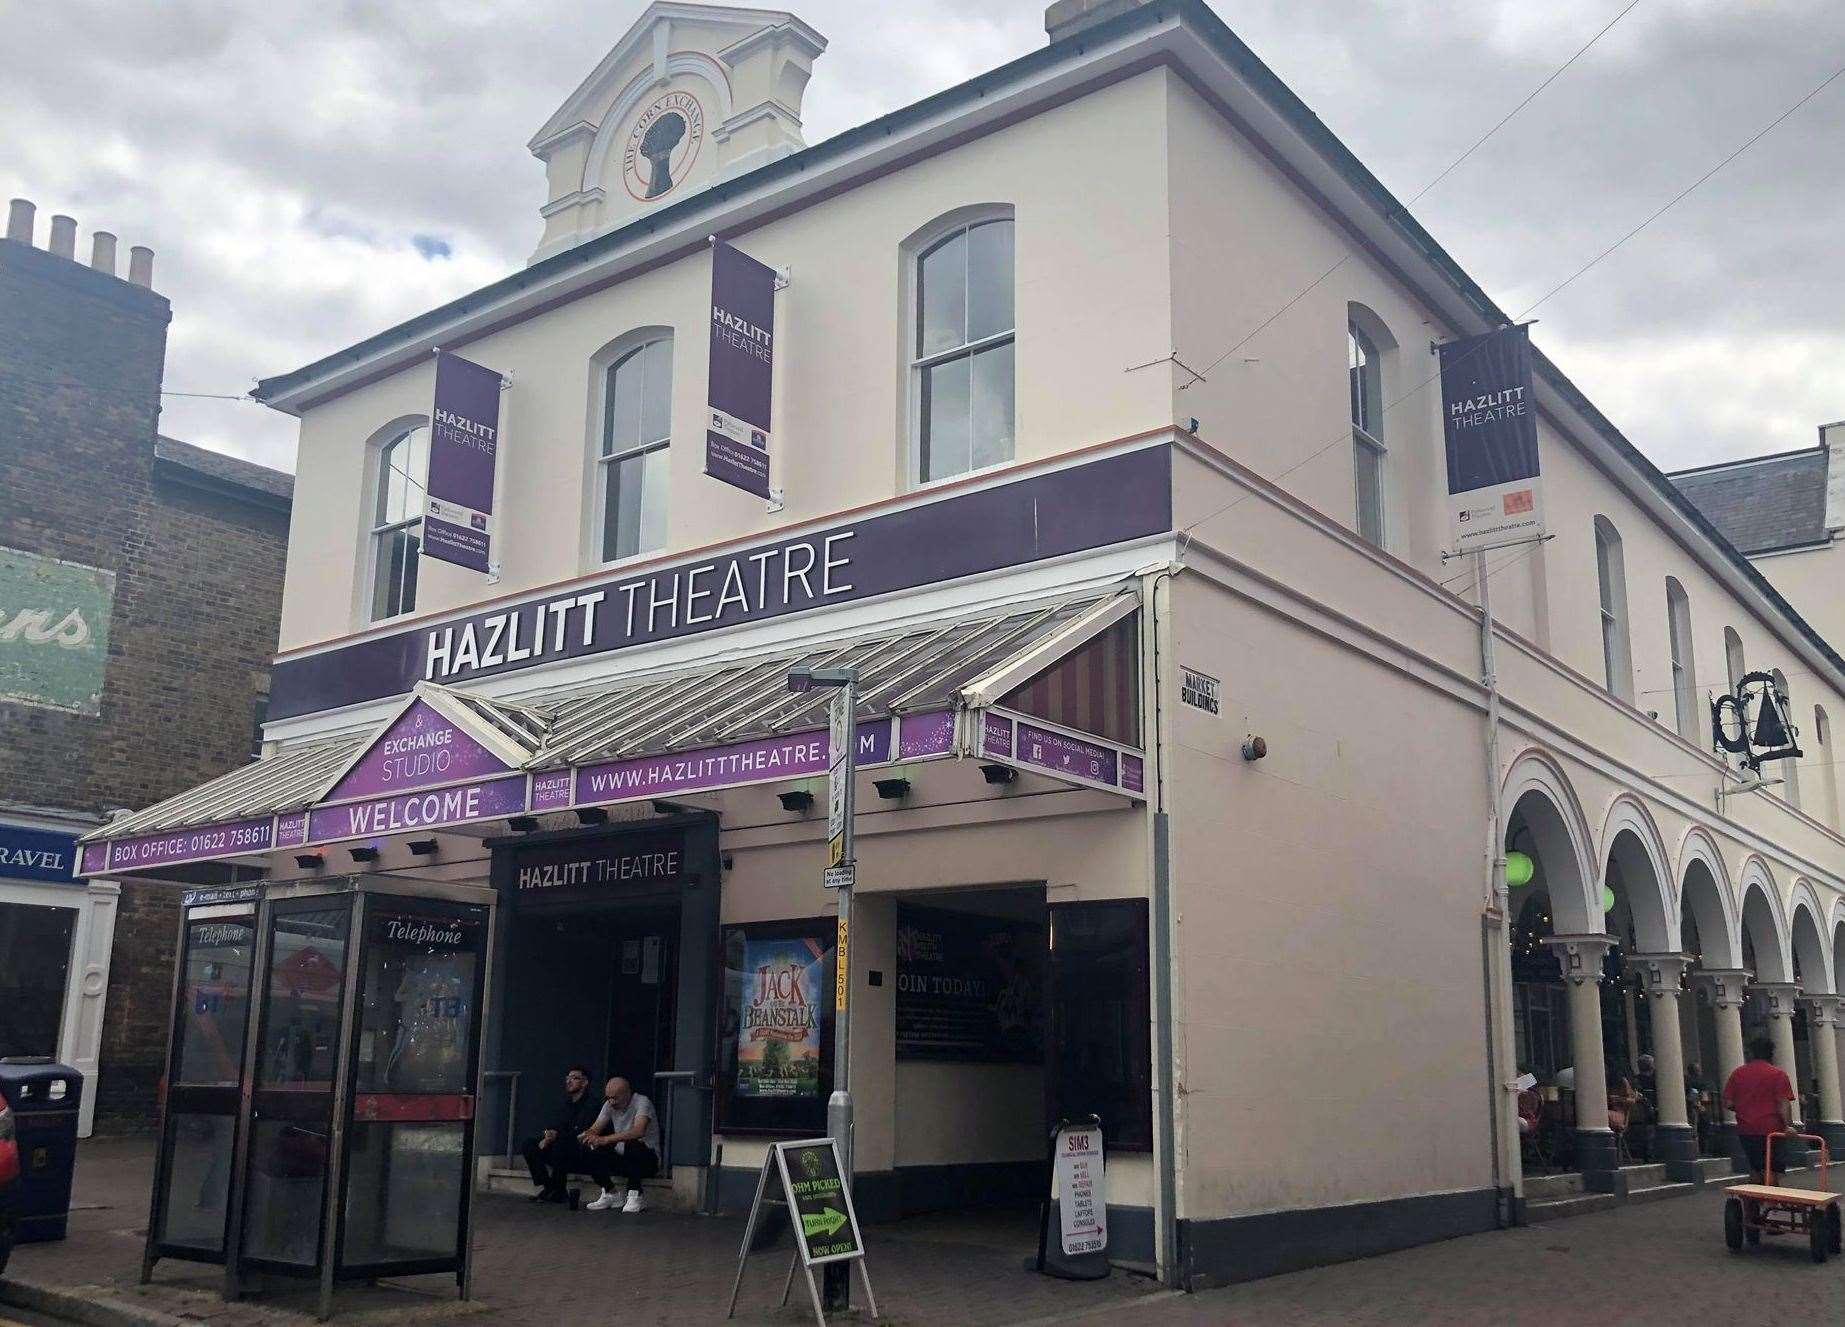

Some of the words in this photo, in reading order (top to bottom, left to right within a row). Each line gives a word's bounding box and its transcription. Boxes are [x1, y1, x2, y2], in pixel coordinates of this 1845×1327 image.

[713, 306, 772, 346] HAZLITT
[713, 322, 772, 364] THEATRE
[1451, 386, 1525, 417] HAZLITT
[435, 408, 496, 440] HAZLITT
[1453, 401, 1526, 430] THEATRE
[435, 422, 496, 455] THEATRE
[425, 590, 606, 680] HAZLITT
[619, 531, 855, 638] THEATRE
[1185, 672, 1215, 698] MARKET
[1181, 686, 1219, 715] BUILDINGS
[415, 713, 424, 729] &
[985, 724, 1011, 740] HAZLITT
[384, 729, 453, 756] EXCHANGE
[985, 734, 1011, 750] HEATRE
[1028, 730, 1044, 743] FIND
[1043, 735, 1053, 745] US
[1052, 738, 1063, 748] ON
[1063, 740, 1084, 755] SOCIAL
[382, 749, 451, 782] STUDIO
[591, 733, 875, 793] WWW.HAZLITTTHEATRE.M
[535, 777, 571, 791] HAZLITT
[535, 788, 571, 802] THEATRE
[348, 787, 481, 834] WELCOME
[279, 818, 305, 833] HAZLITT
[279, 827, 305, 841] THEATRE
[115, 846, 138, 862] BOX
[142, 839, 187, 858] OFFICE:
[191, 831, 226, 851] 01622
[230, 826, 271, 845] 758611
[519, 861, 592, 890] HAZLITT
[595, 851, 678, 882] THEATRE
[832, 878, 841, 886] any
[200, 925, 245, 946] Telephone
[388, 920, 463, 945] Telephone
[753, 964, 806, 1008] JACK
[744, 1003, 818, 1030] BEANSTALK
[1068, 1135, 1090, 1152] SIM3
[812, 1244, 830, 1257] NOW
